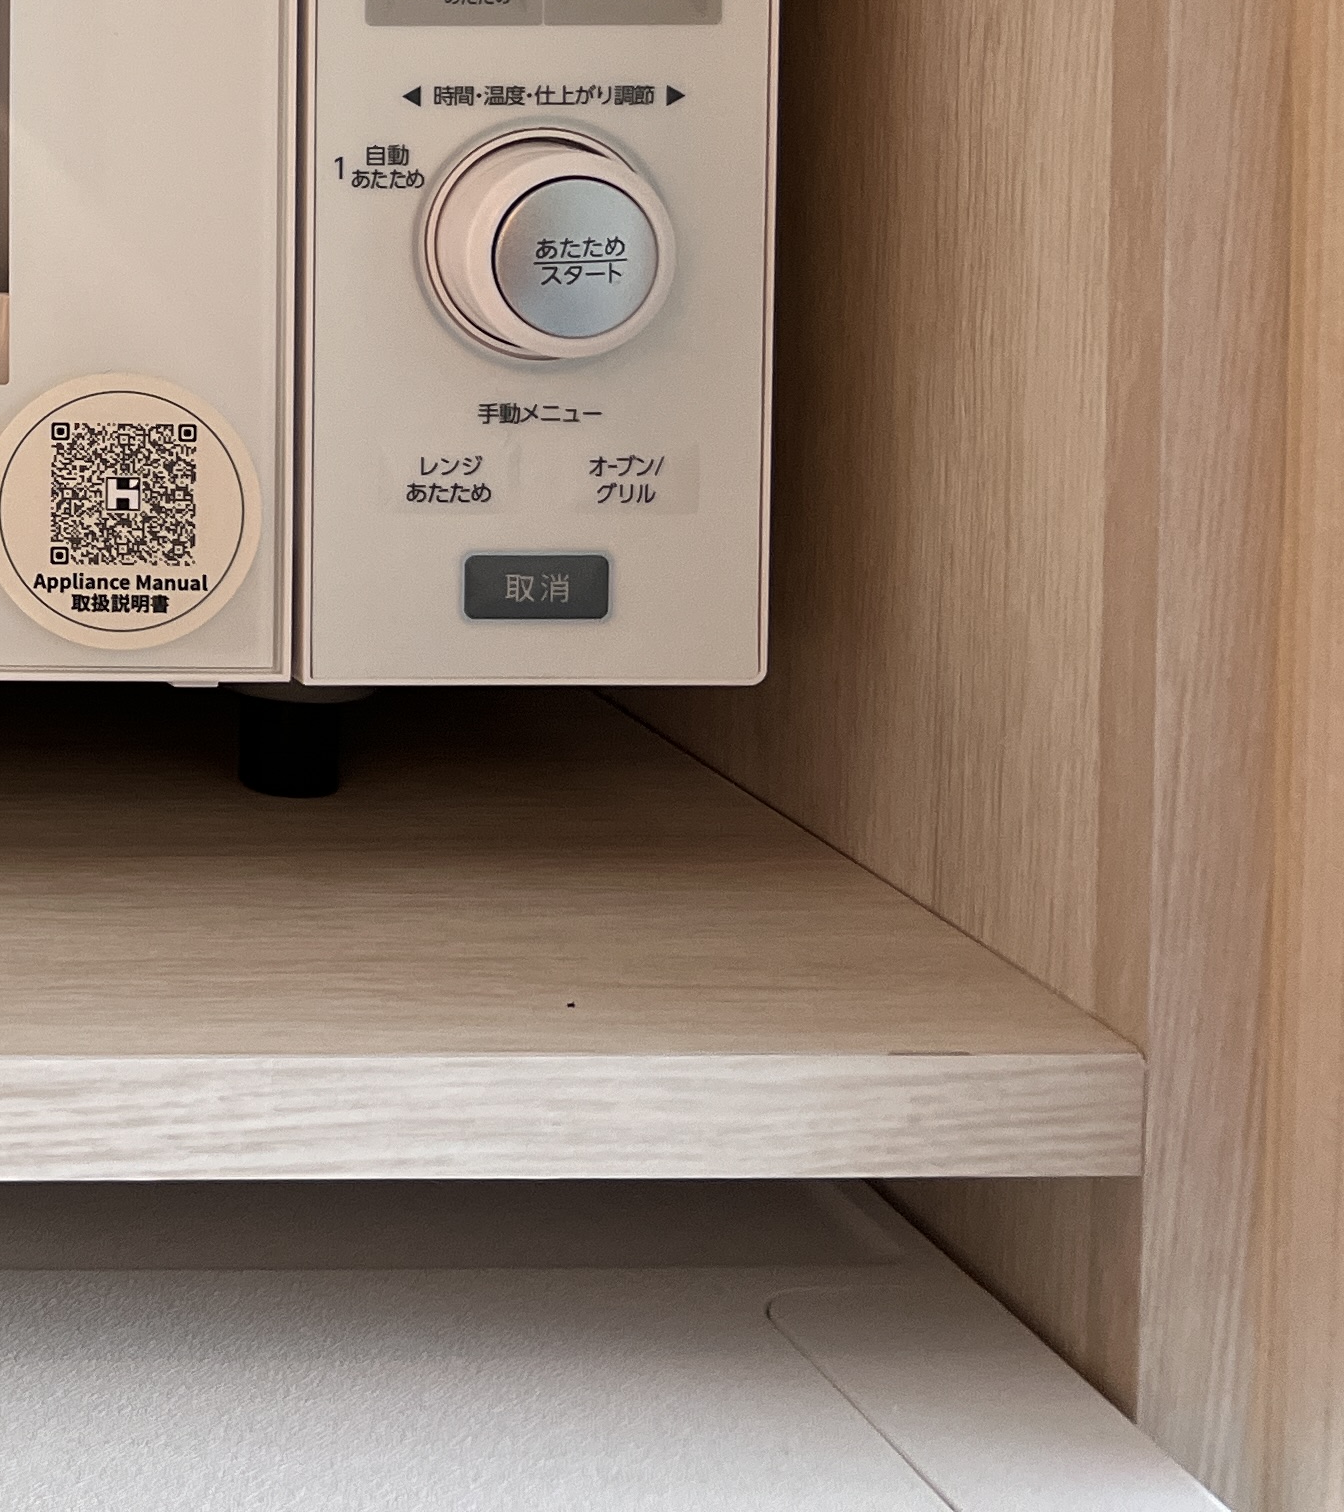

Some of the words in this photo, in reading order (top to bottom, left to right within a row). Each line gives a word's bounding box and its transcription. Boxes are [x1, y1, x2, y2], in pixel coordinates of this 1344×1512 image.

[365, 143, 410, 167] 自動
[333, 156, 344, 180] 1
[351, 168, 426, 190] あたため
[534, 236, 628, 260] あたため
[539, 264, 625, 286] スタート
[477, 402, 604, 425] 手動メニュー
[420, 455, 484, 476] レンジ
[405, 482, 492, 504] あたため
[596, 483, 657, 505] グリル
[33, 572, 130, 593] Appliance
[135, 574, 209, 592] Manual
[505, 574, 569, 603] 取消
[70, 593, 170, 614] 取扱説明書
